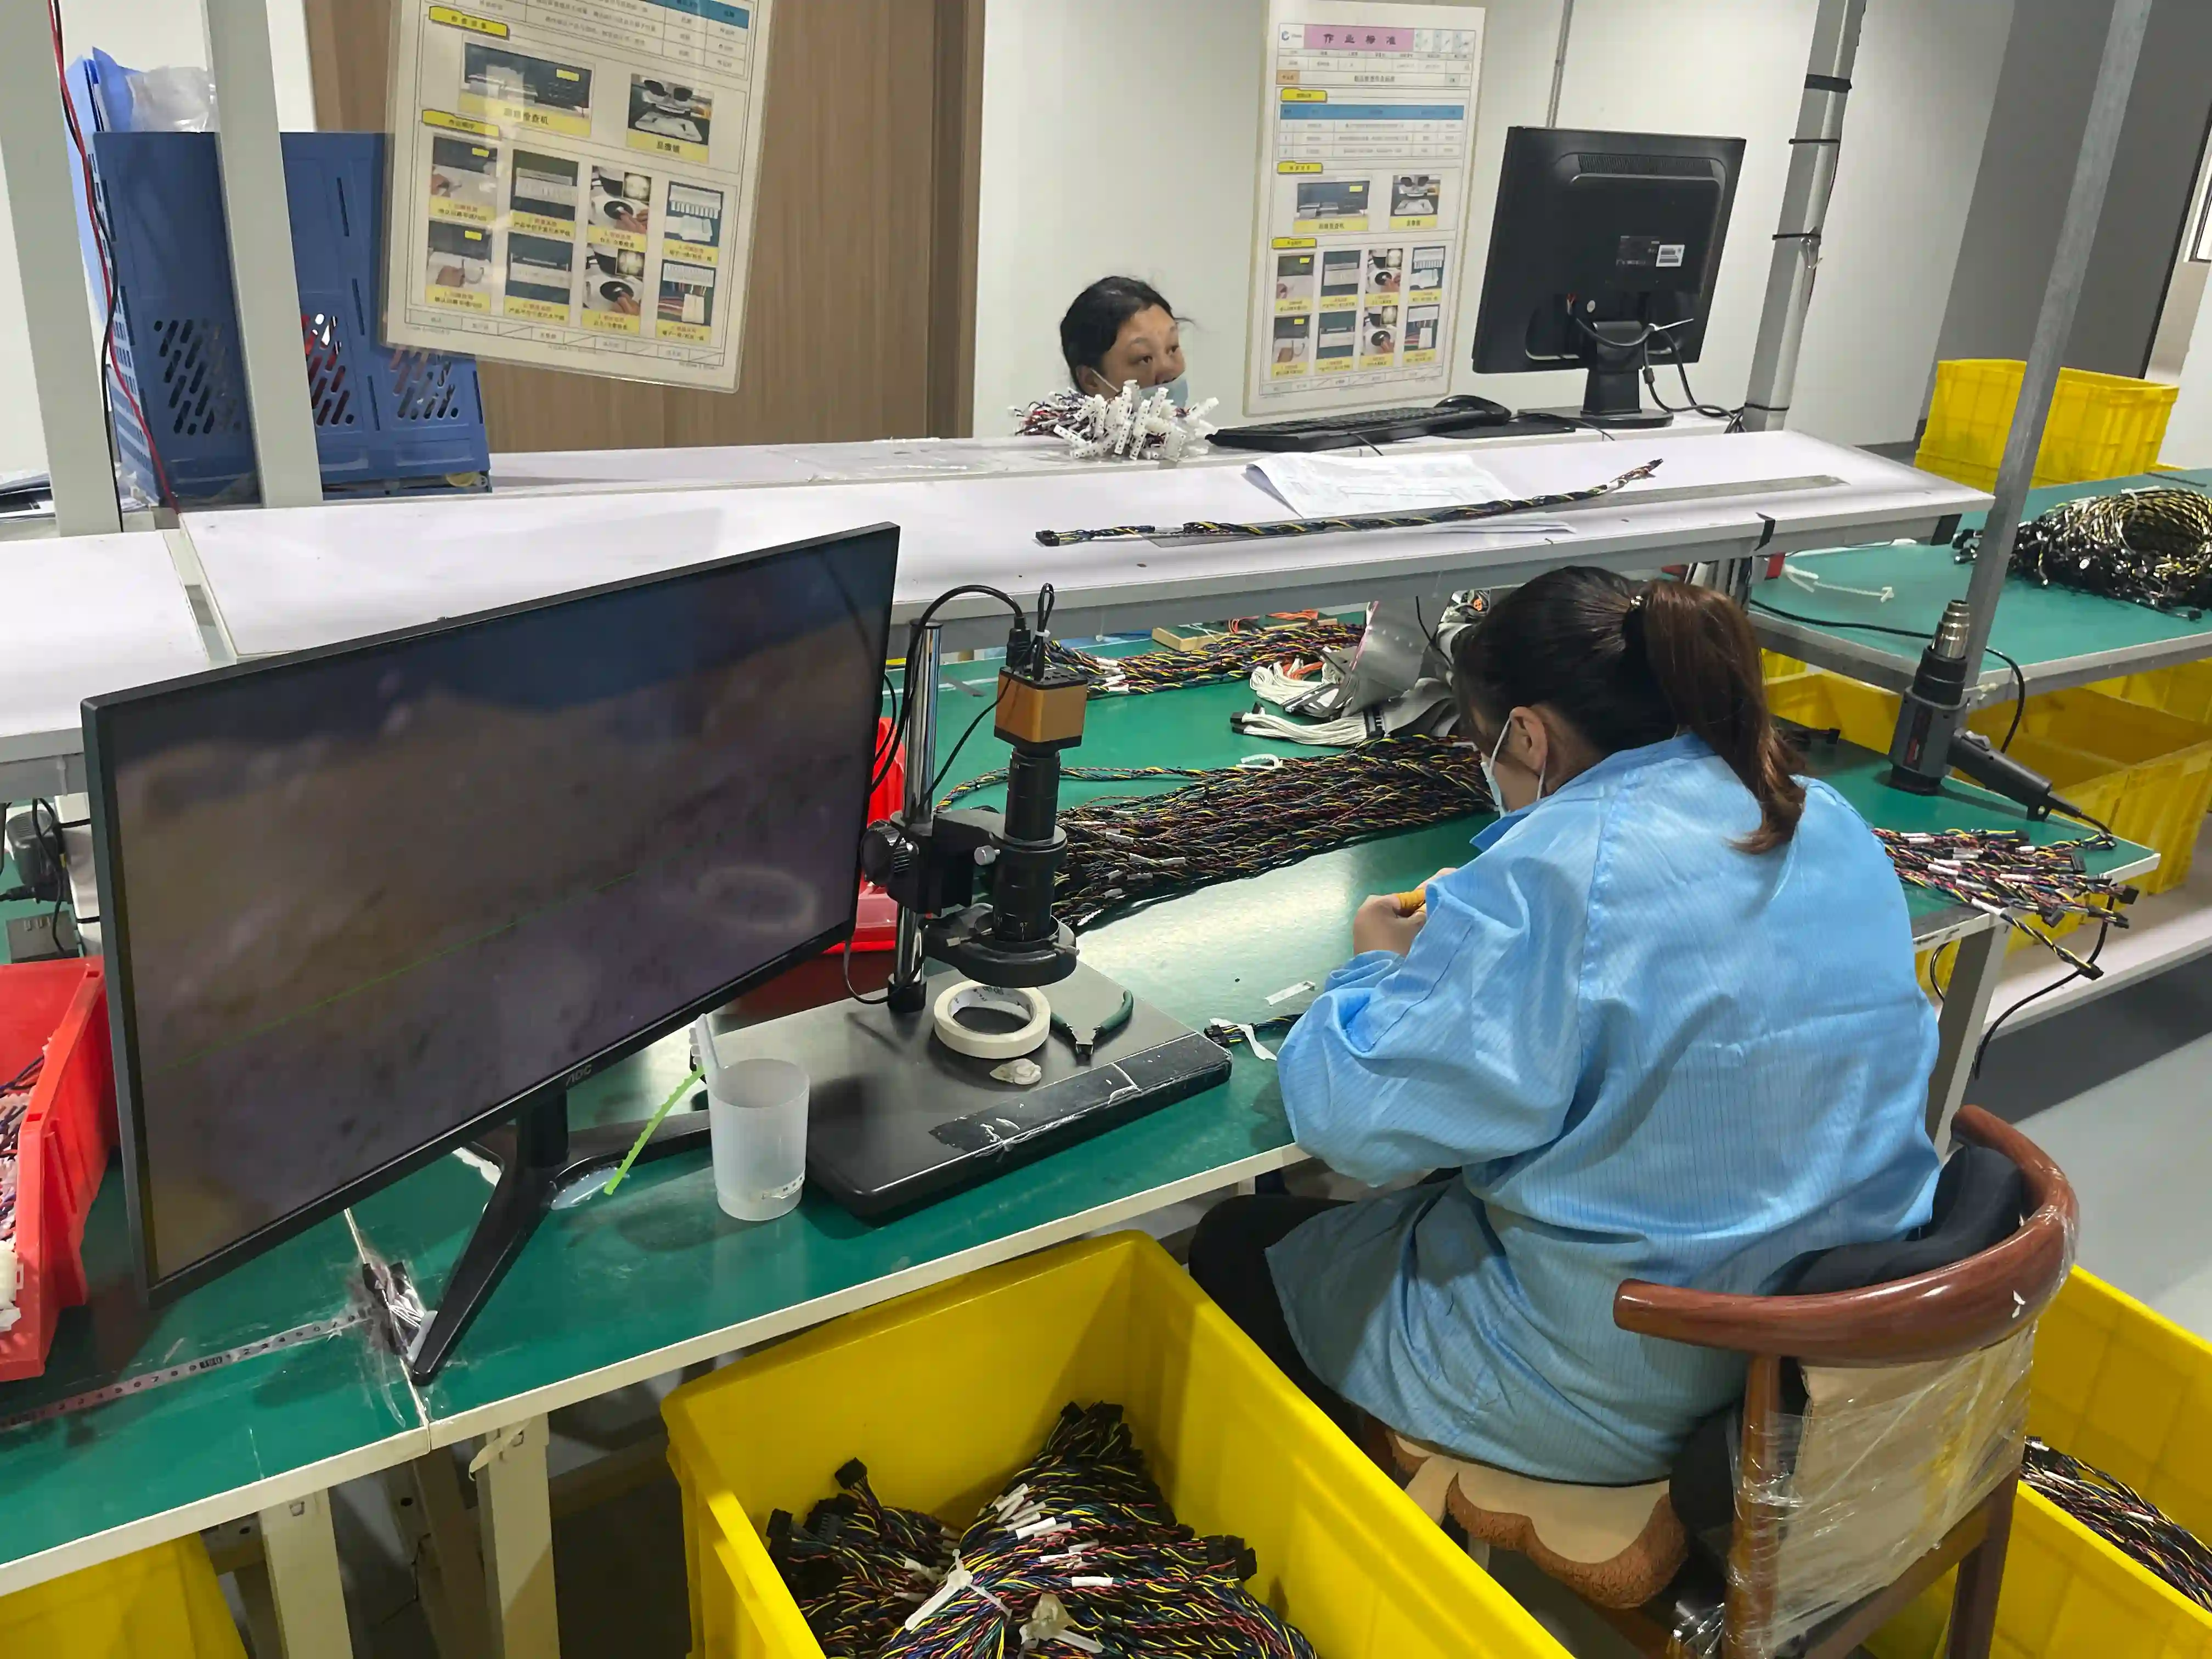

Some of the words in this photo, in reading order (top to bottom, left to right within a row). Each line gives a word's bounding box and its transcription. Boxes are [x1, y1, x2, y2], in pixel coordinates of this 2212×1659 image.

[1323, 33, 1396, 45] 作业标准
[566, 1064, 592, 1086] AOC
